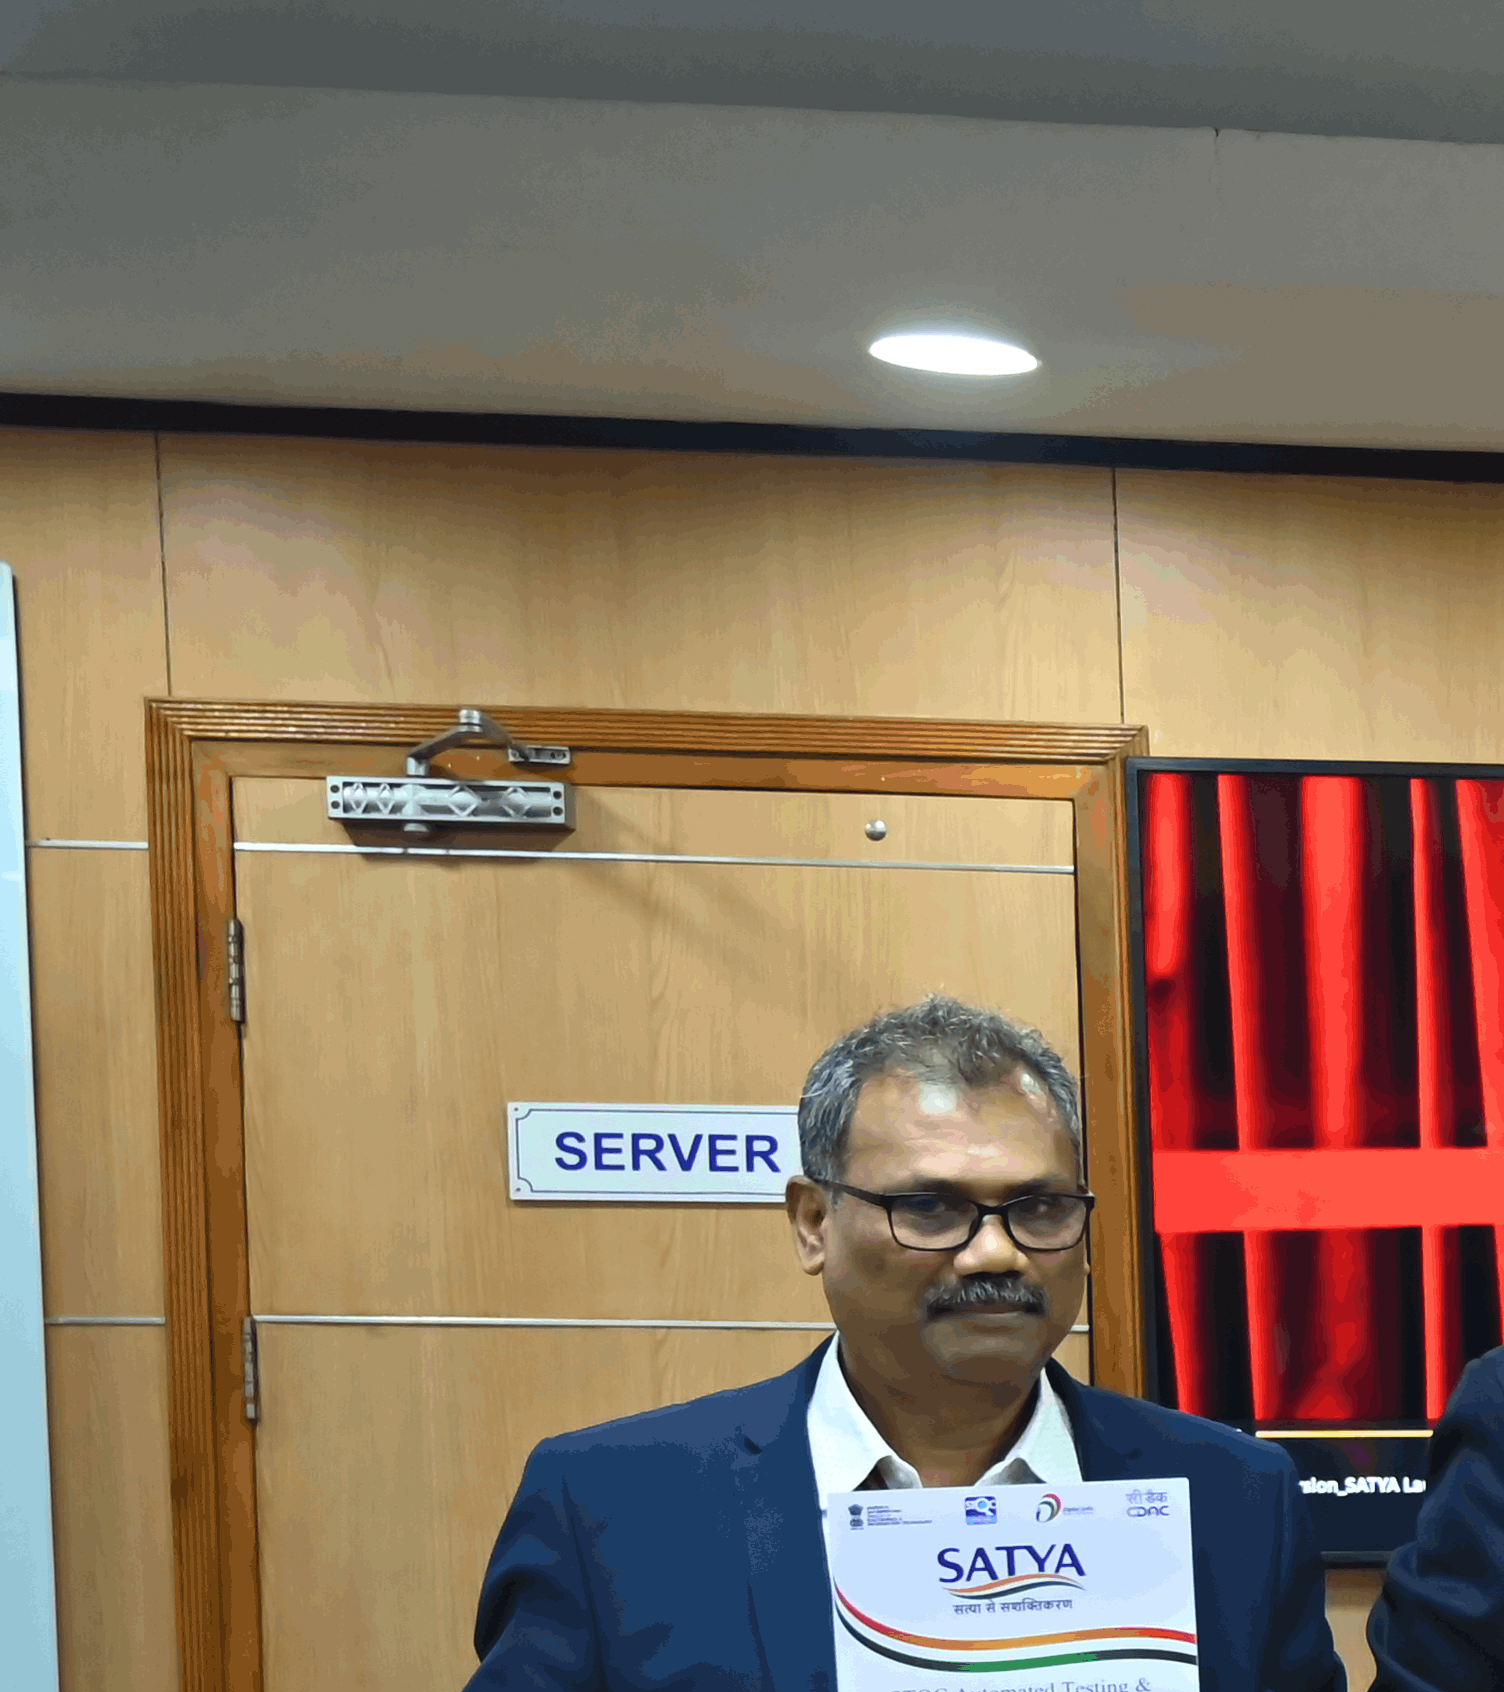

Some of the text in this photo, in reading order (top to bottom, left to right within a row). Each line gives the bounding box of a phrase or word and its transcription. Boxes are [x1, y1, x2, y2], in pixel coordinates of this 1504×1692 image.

[554, 1131, 781, 1173] SERVER
[1299, 1476, 1400, 1496] sion_SATYA
[937, 1543, 1087, 1583] SATYA
[1135, 1678, 1152, 1692] &
